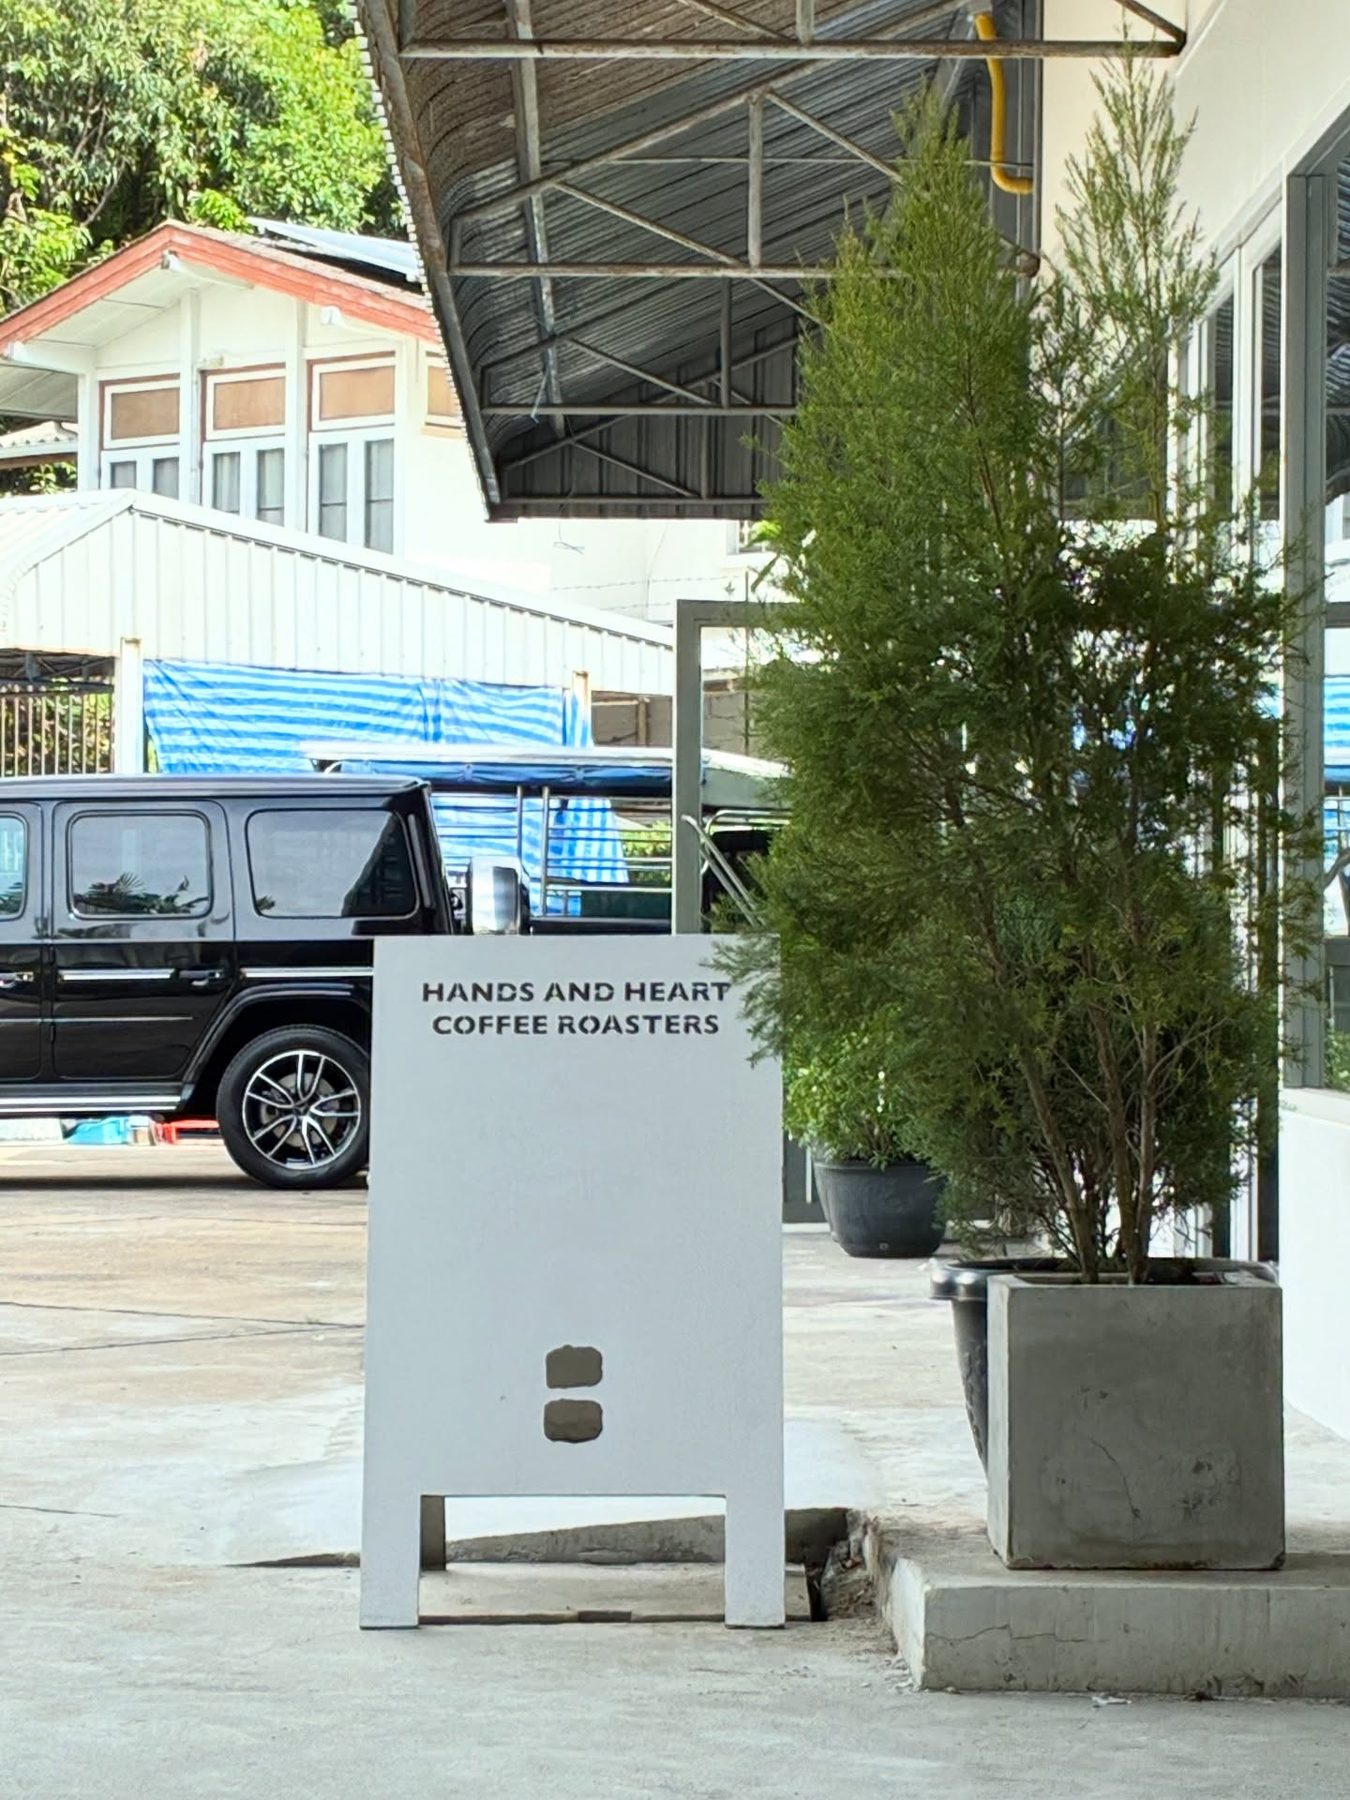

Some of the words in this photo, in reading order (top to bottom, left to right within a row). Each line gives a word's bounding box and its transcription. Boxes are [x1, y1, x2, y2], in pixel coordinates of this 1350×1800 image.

[422, 981, 535, 1003] HANDS
[543, 981, 615, 1003] AND
[624, 981, 732, 1003] HEART
[432, 1014, 549, 1036] COFFEE
[557, 1014, 720, 1036] ROASTERS
